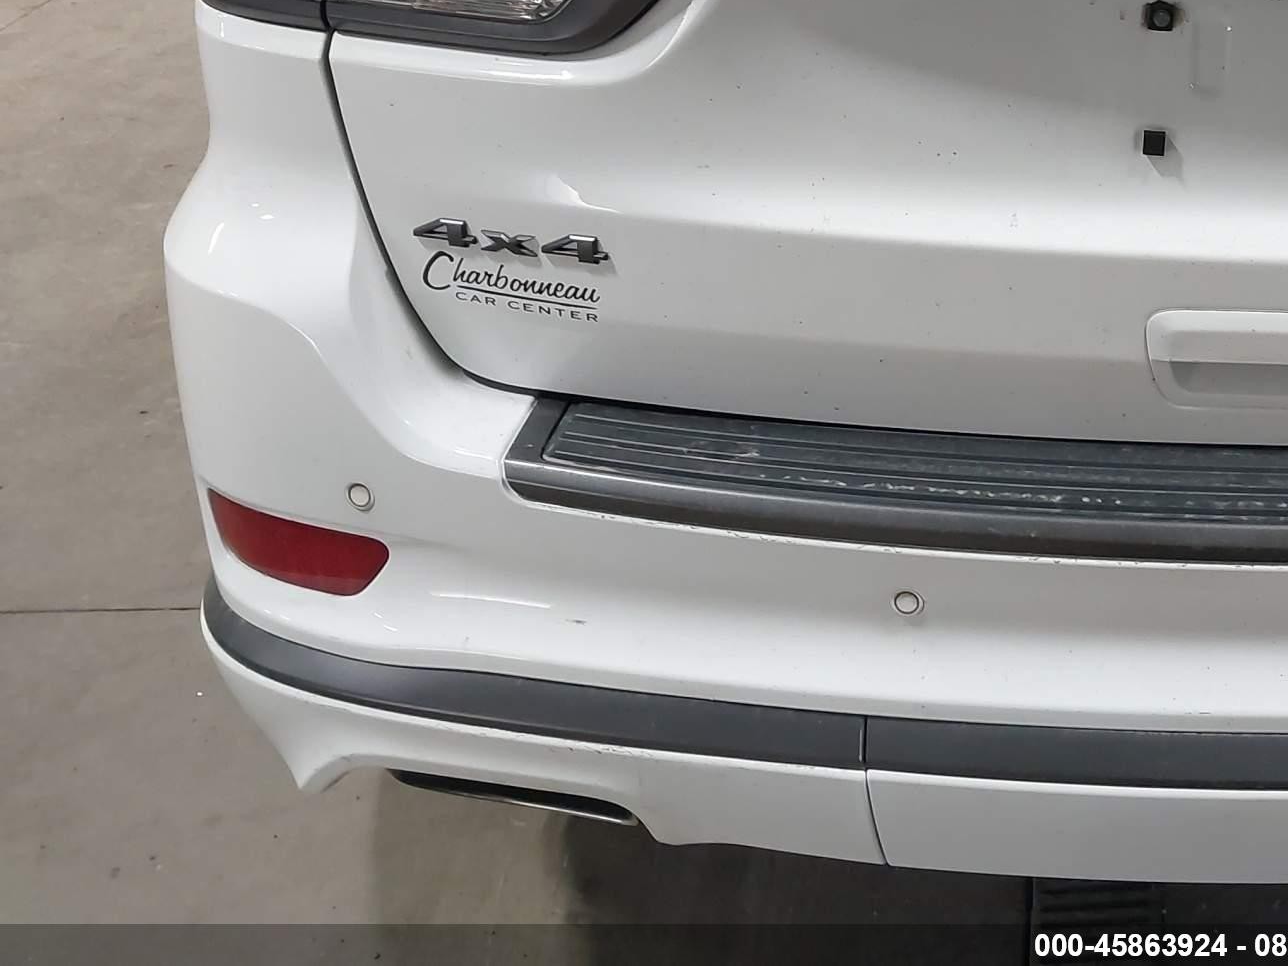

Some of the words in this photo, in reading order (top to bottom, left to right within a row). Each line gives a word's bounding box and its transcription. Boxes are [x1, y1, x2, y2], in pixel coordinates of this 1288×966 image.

[422, 250, 601, 304] Charbonneau
[455, 291, 498, 307] CAR
[507, 300, 599, 323] CENTER
